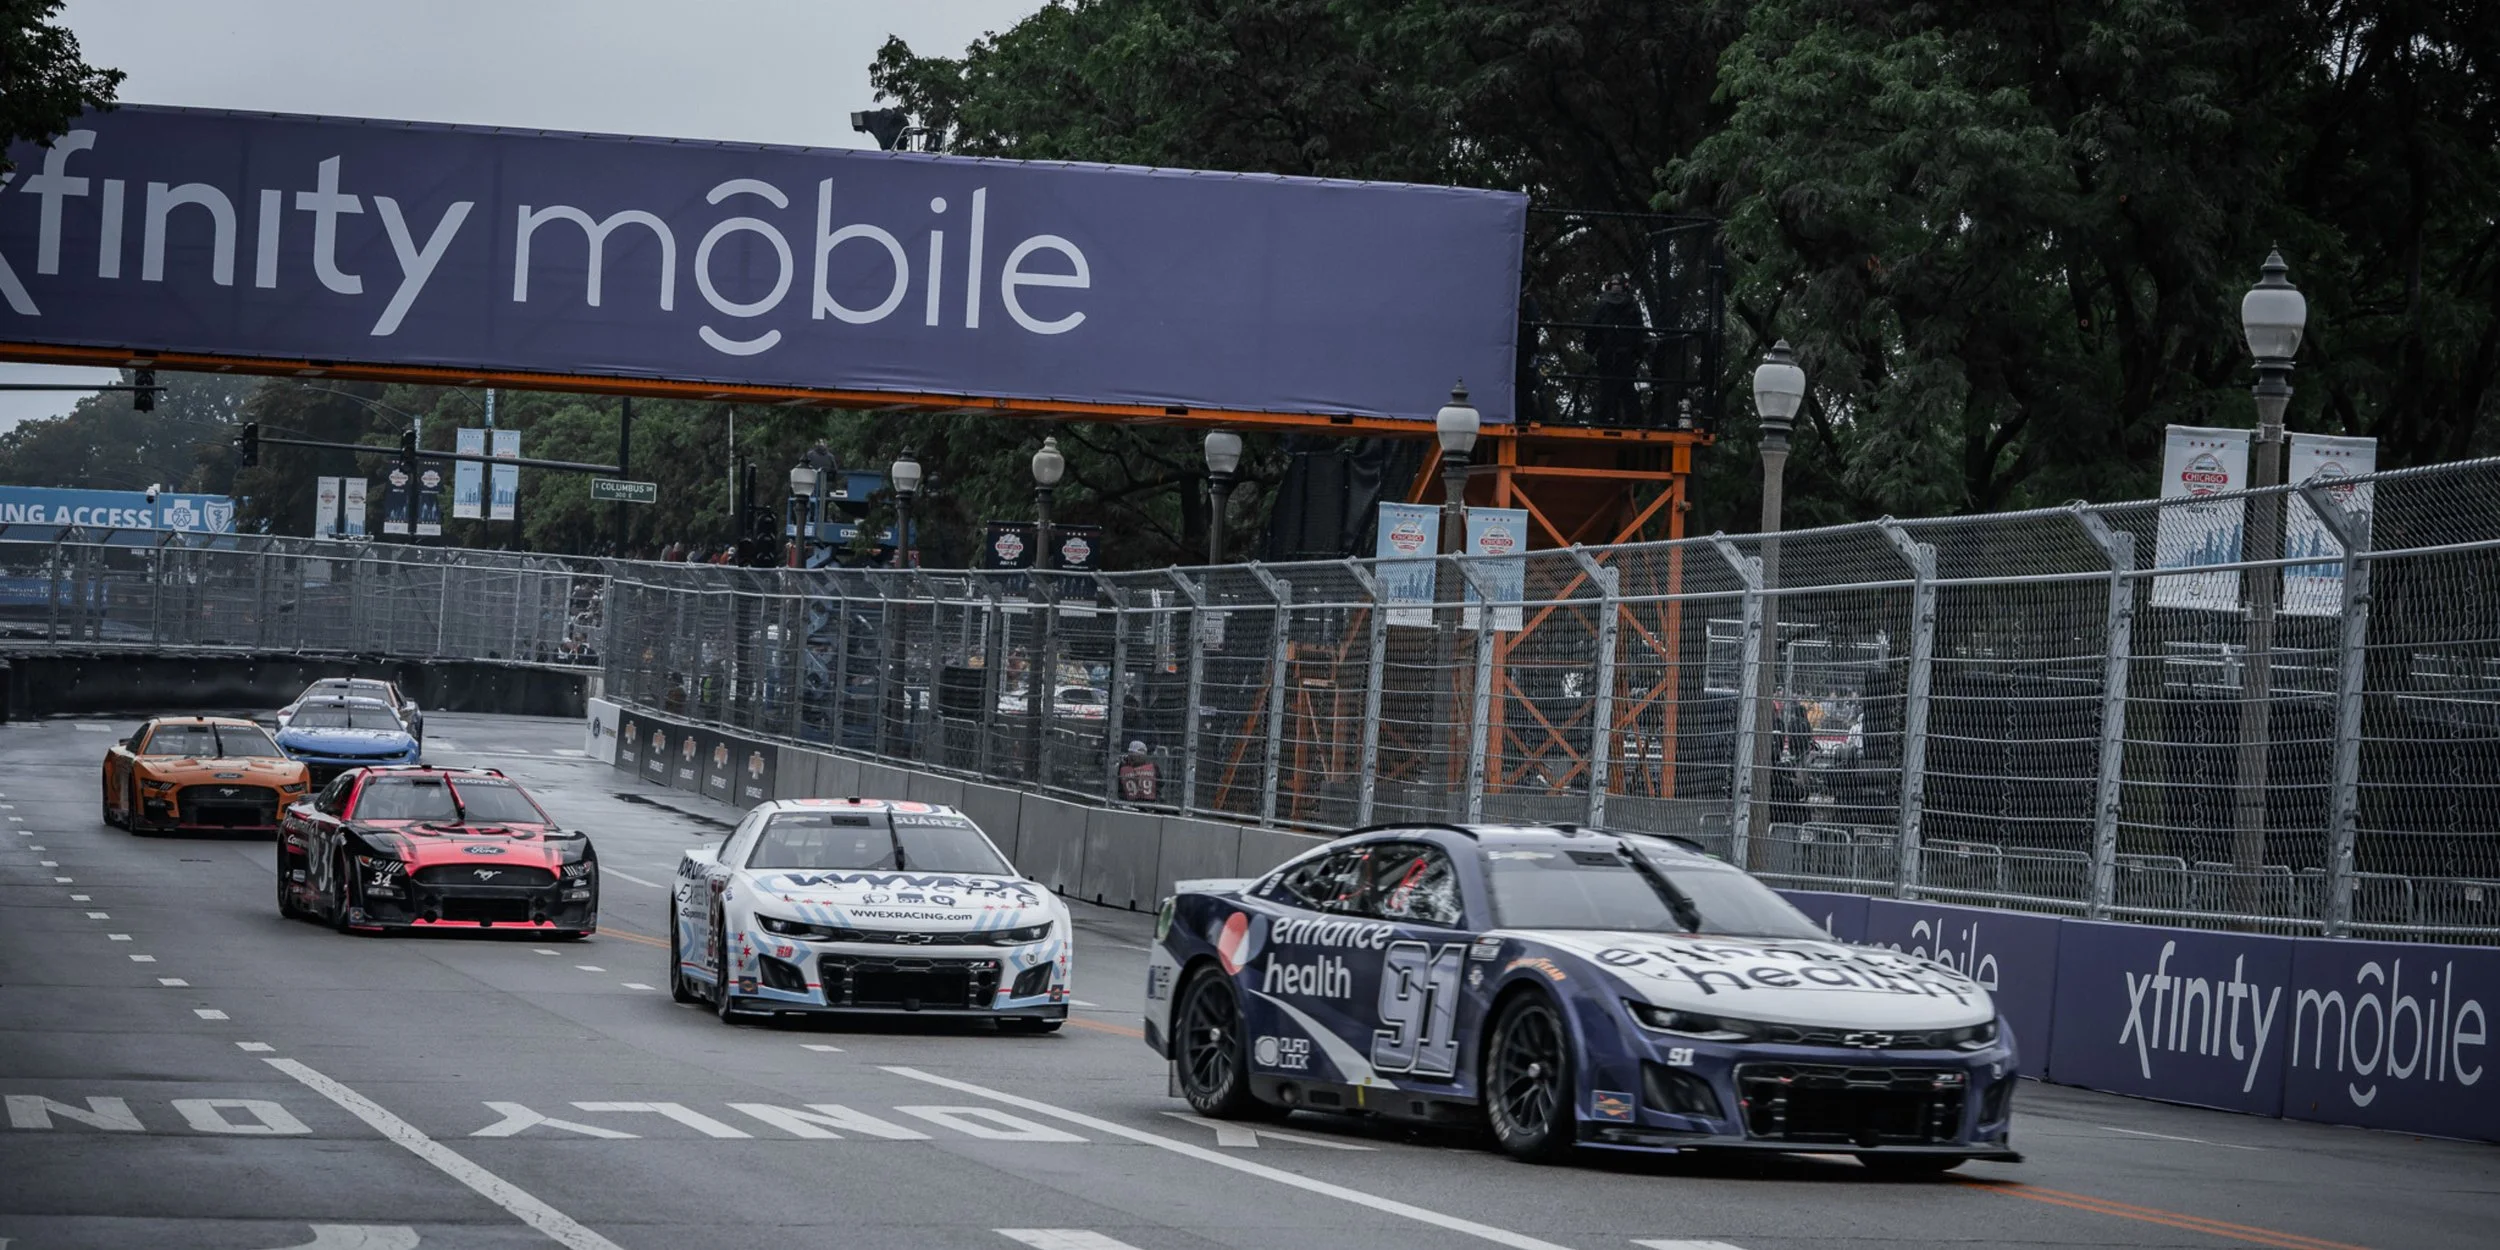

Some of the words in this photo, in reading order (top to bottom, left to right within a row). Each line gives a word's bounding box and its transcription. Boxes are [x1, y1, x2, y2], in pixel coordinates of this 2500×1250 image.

[601, 482, 645, 493] COLUMBUS
[2185, 472, 2224, 484] CHICAGO
[54, 505, 153, 528] ACCESS
[371, 871, 393, 887] 34
[851, 908, 973, 921] WWEXRACING.com
[1271, 913, 1395, 950] enhance
[1263, 952, 1351, 999] health
[1370, 940, 1468, 1078] 91
[2119, 940, 2282, 1092] xfinity
[1278, 1054, 1309, 1070] LOCK
[1667, 1047, 1694, 1066] 91
